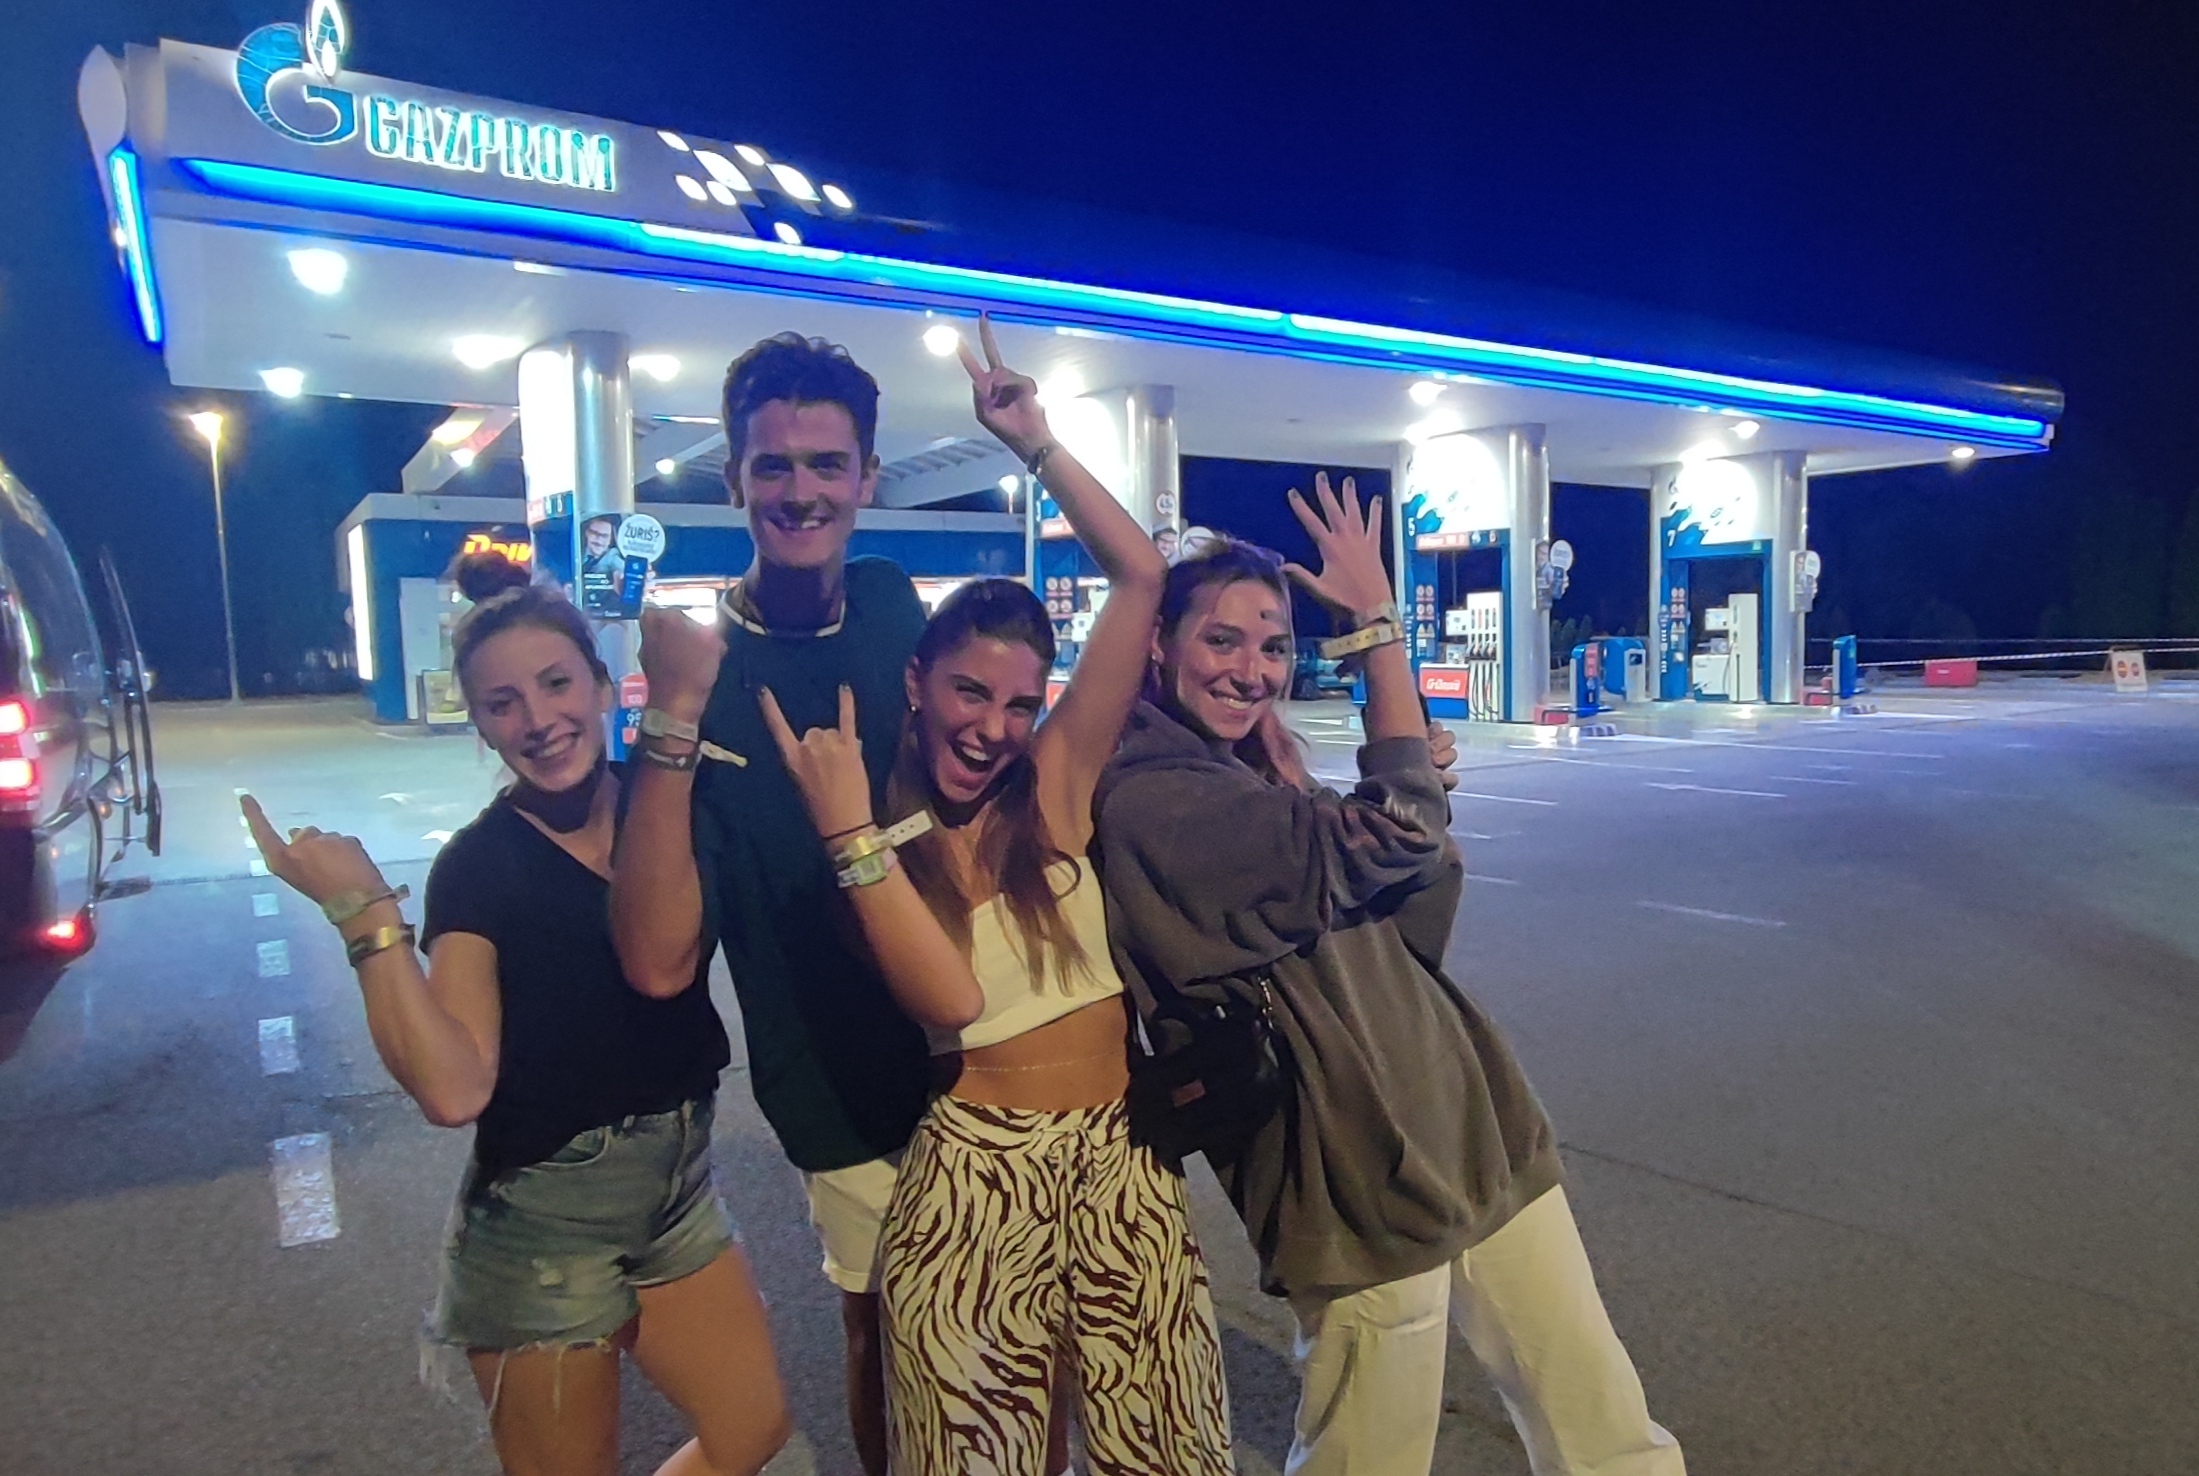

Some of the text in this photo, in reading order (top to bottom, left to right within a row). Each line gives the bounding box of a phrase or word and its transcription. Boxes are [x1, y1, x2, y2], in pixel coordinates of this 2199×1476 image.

[363, 96, 616, 192] GAZPROM
[624, 522, 660, 542] ŽURIŠ?
[1407, 517, 1416, 537] 5
[1667, 530, 1676, 547] 7
